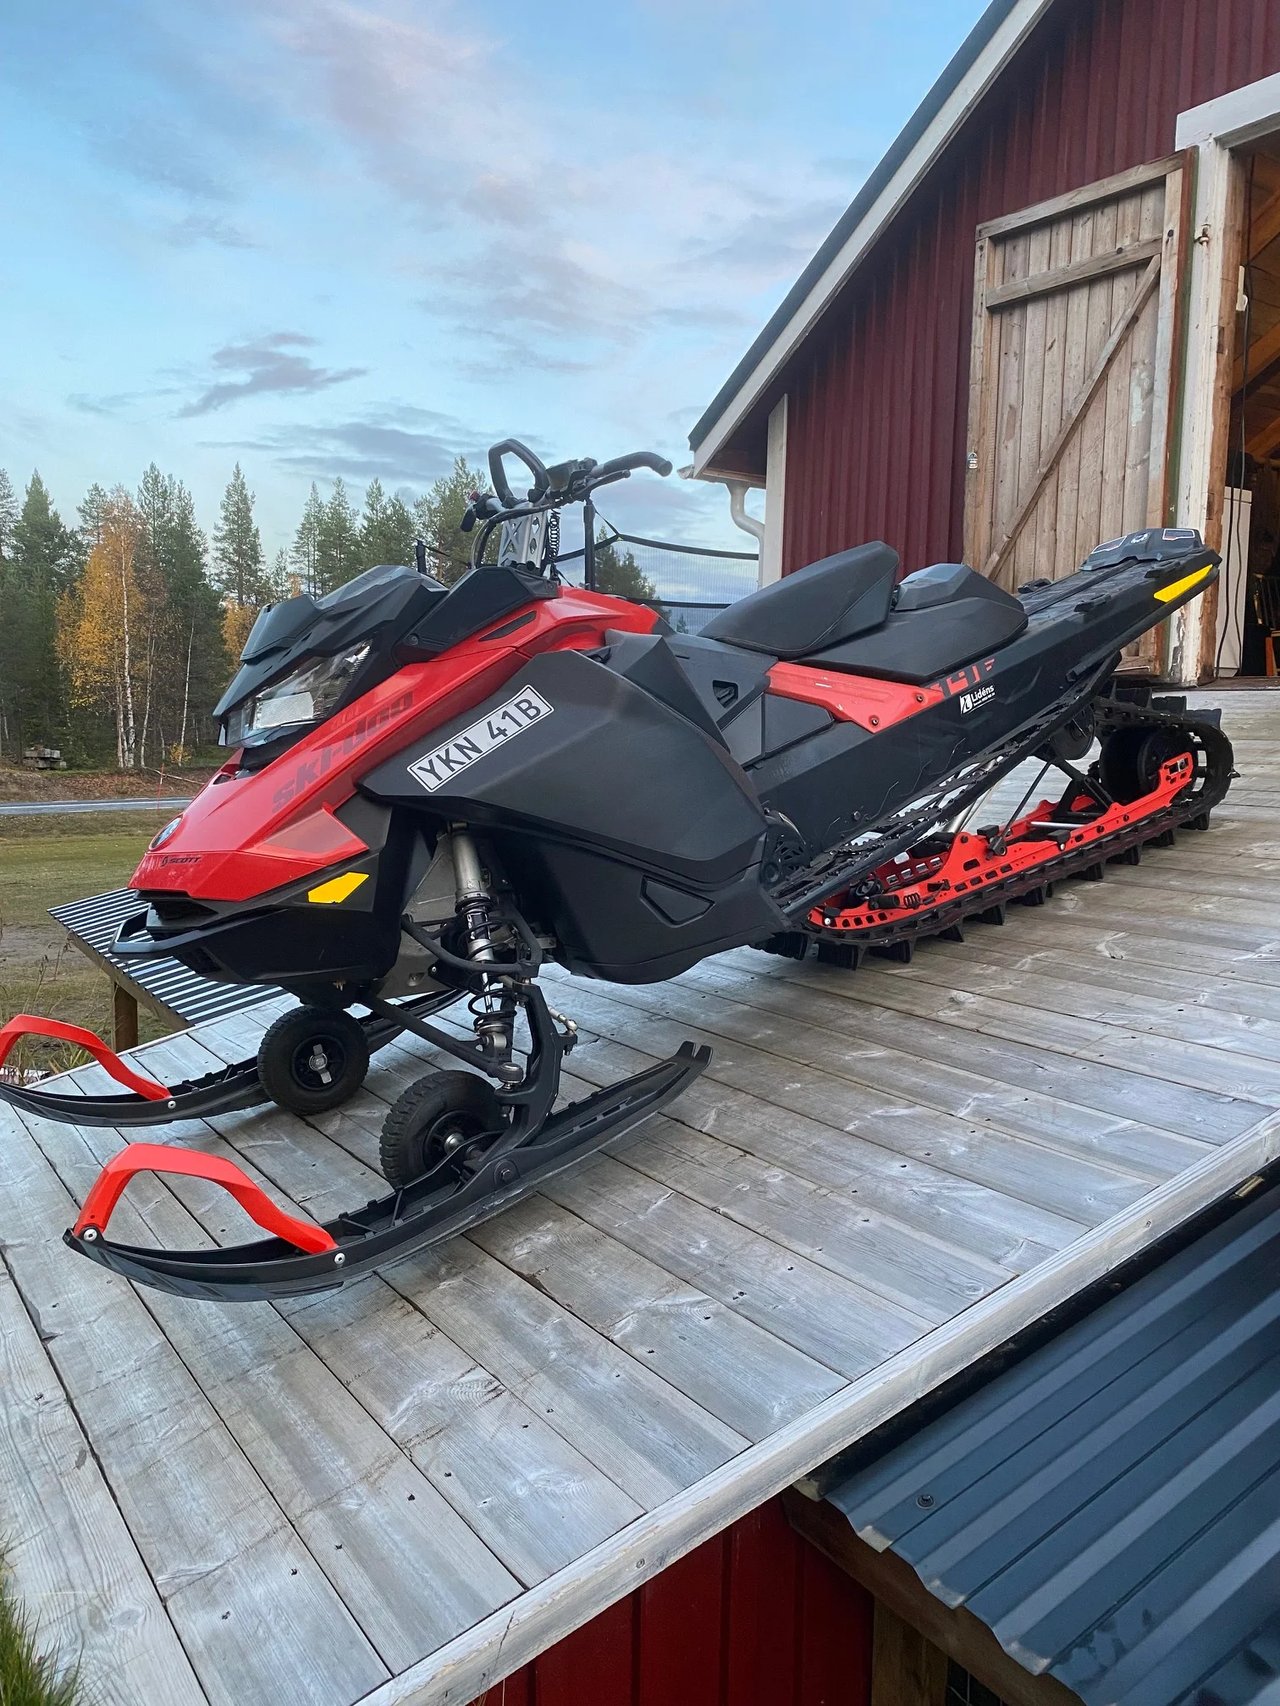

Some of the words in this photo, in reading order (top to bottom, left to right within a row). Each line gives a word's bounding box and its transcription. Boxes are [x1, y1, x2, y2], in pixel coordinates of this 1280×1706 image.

[416, 736, 484, 782] YKN
[486, 698, 541, 740] 41B
[169, 856, 202, 865] SCOTT
